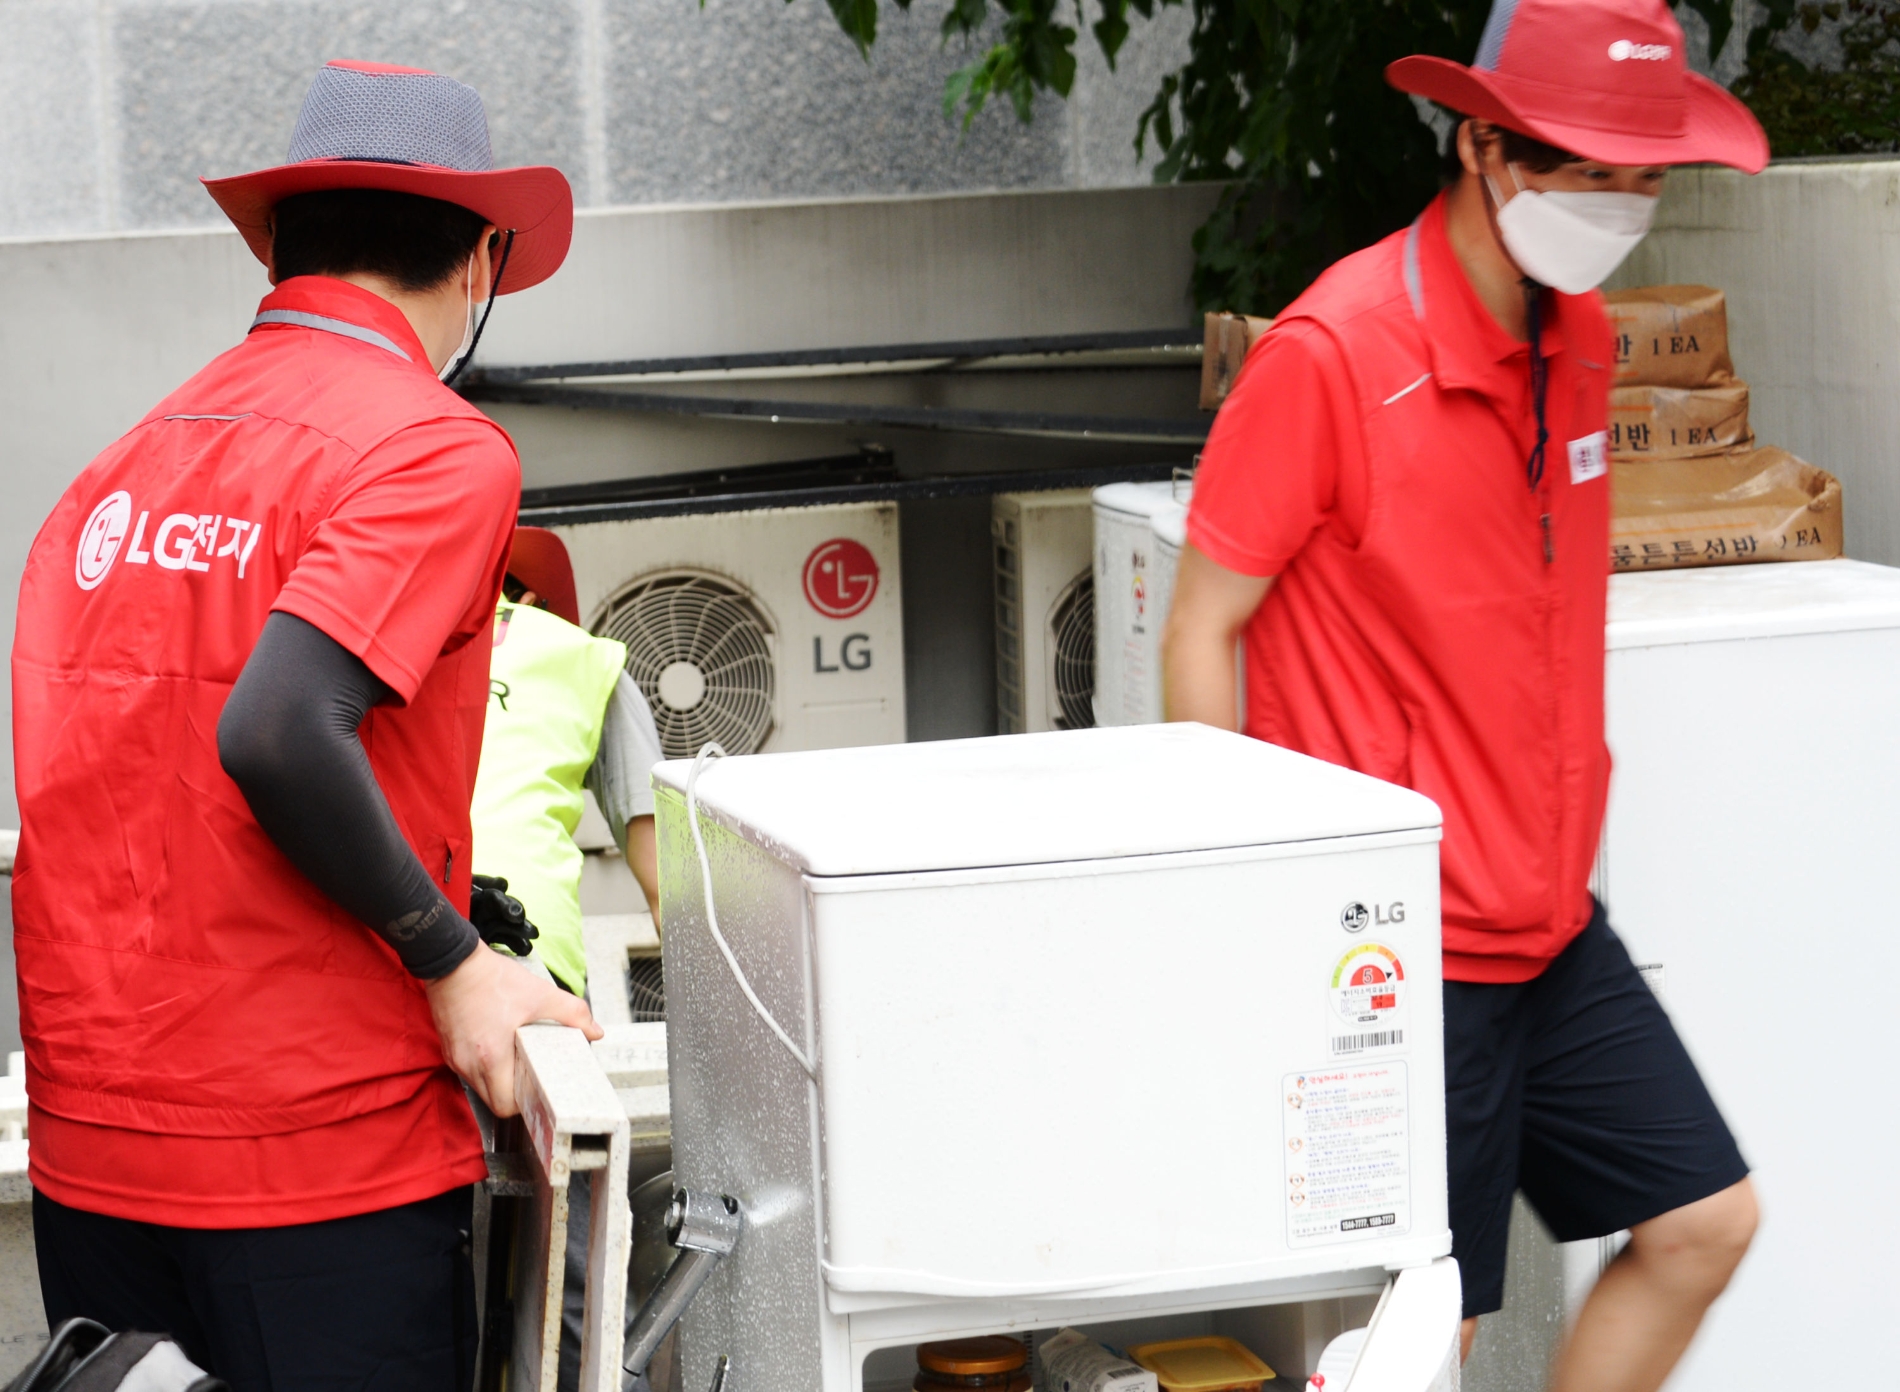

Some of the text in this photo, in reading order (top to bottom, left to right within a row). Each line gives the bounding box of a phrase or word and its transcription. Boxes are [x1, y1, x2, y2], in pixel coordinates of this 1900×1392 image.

[1670, 335, 1700, 354] EA
[1688, 427, 1717, 445] EA
[1796, 527, 1822, 548] EA
[813, 632, 872, 673] LG
[414, 898, 446, 934] NEPA
[1374, 901, 1406, 926] LG
[1362, 968, 1373, 984] 5
